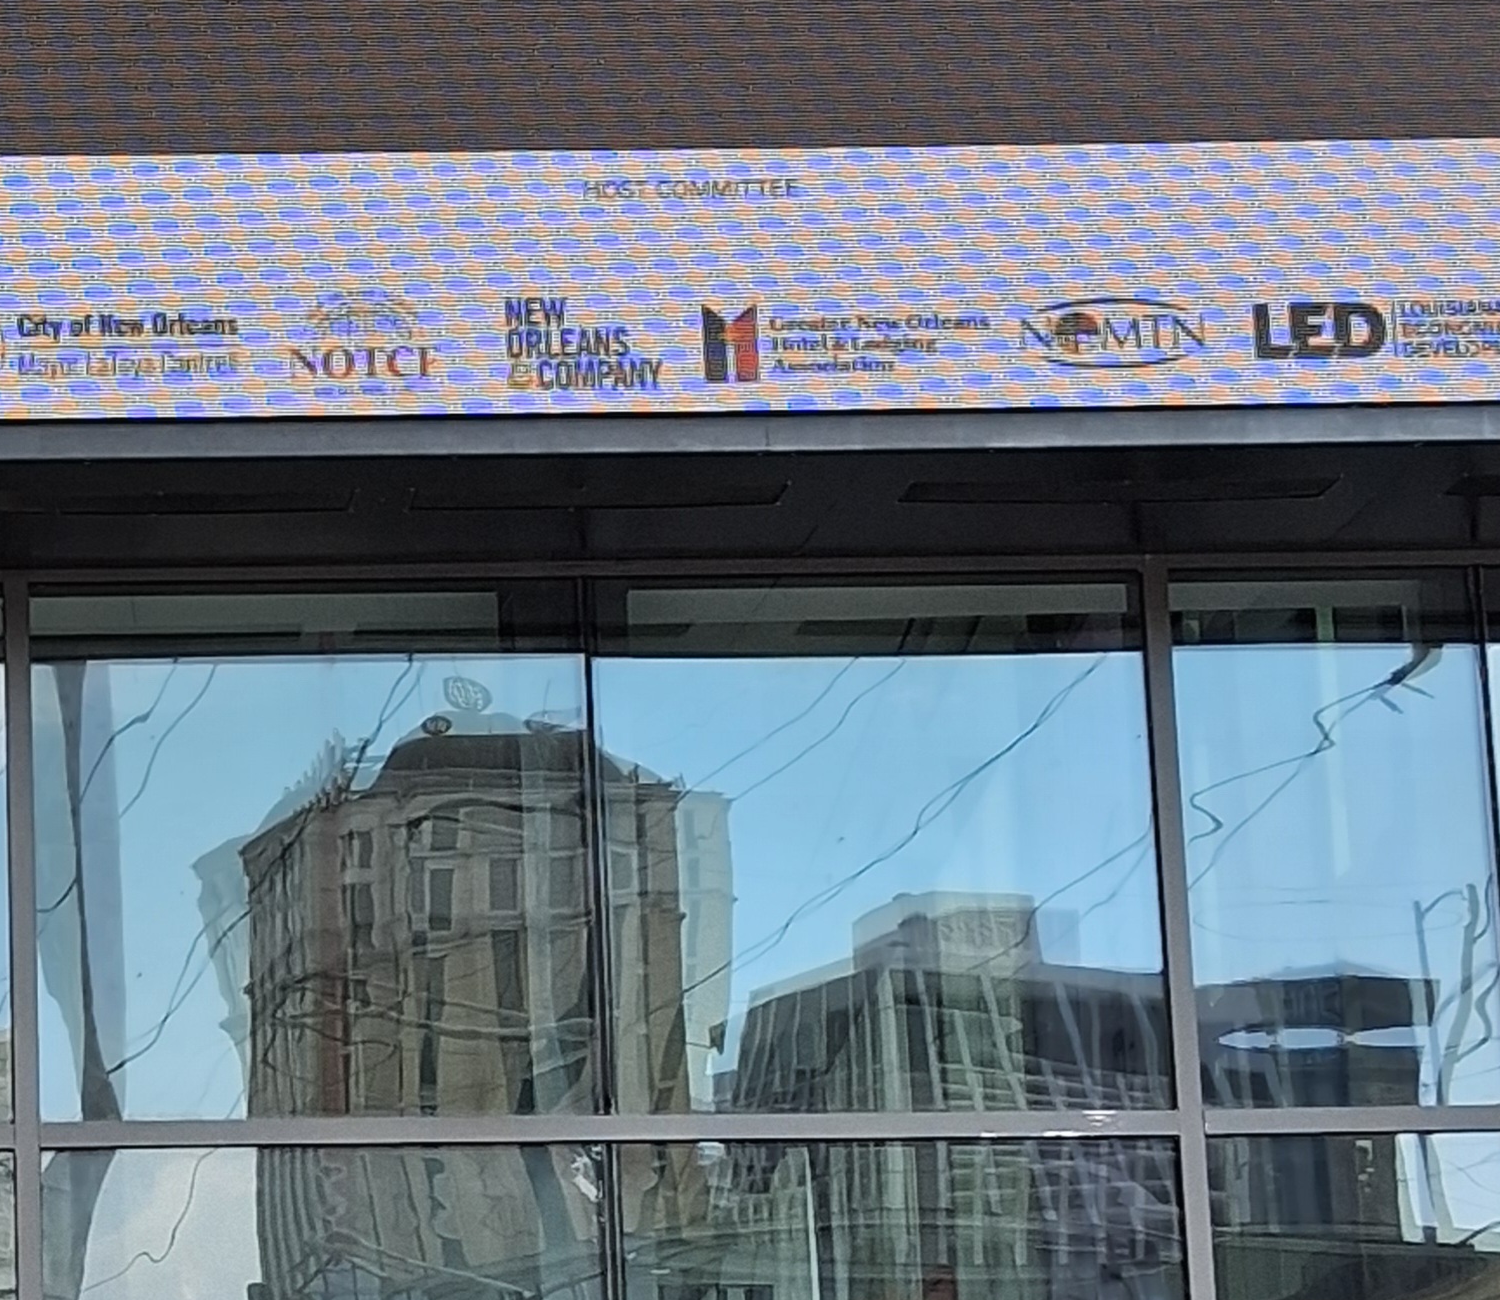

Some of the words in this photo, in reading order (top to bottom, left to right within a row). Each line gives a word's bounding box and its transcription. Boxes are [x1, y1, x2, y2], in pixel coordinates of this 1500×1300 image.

[582, 179, 646, 200] HOST
[654, 179, 802, 201] COMMITTEE
[16, 313, 62, 341] City
[68, 313, 92, 337] of
[99, 313, 145, 337] New
[150, 312, 239, 337] Orleans
[504, 297, 568, 327] NEW
[768, 314, 851, 333] Greater
[856, 314, 900, 333] New
[904, 312, 992, 332] Orleans
[506, 327, 631, 360] ORLEANS
[770, 334, 828, 354] Hotel
[851, 334, 938, 356] Lodging
[1252, 301, 1388, 361] LED
[536, 358, 664, 392] COMPANY
[771, 355, 895, 375] Association
